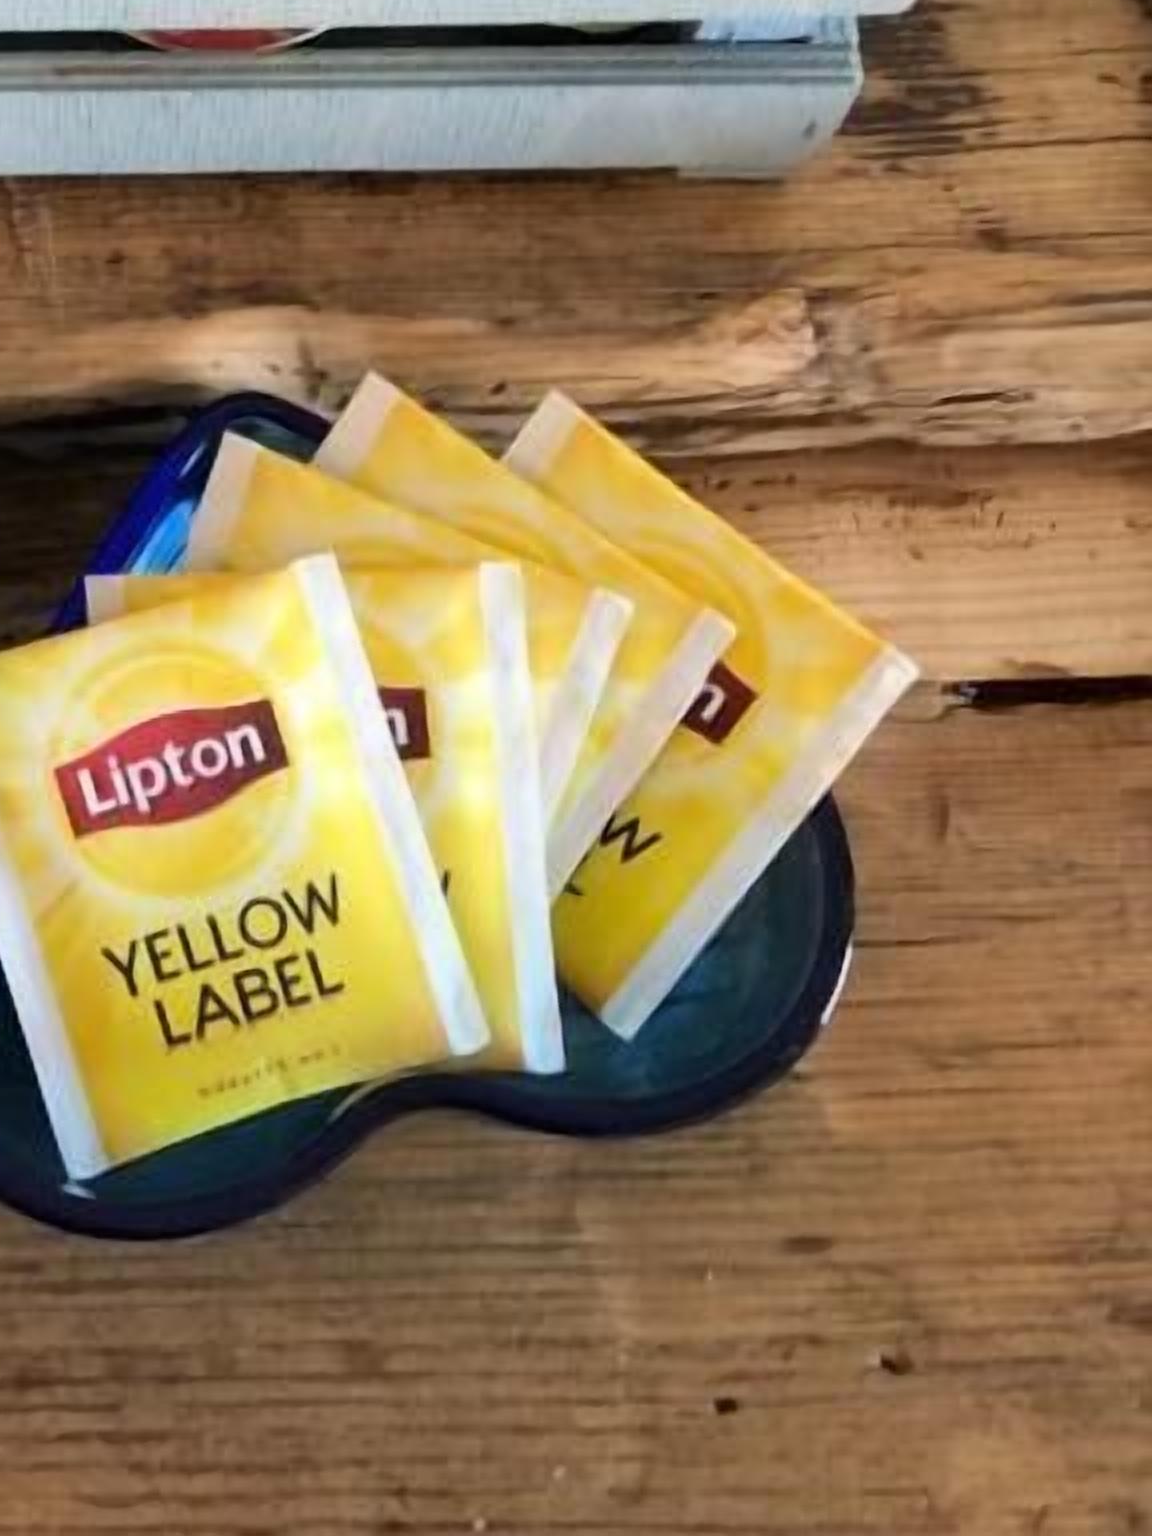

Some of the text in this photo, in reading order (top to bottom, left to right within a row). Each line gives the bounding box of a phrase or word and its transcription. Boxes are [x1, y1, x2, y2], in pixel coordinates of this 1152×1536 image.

[77, 725, 266, 815] Lipton
[101, 872, 341, 997] YELLOW
[153, 949, 345, 1047] LABEL
